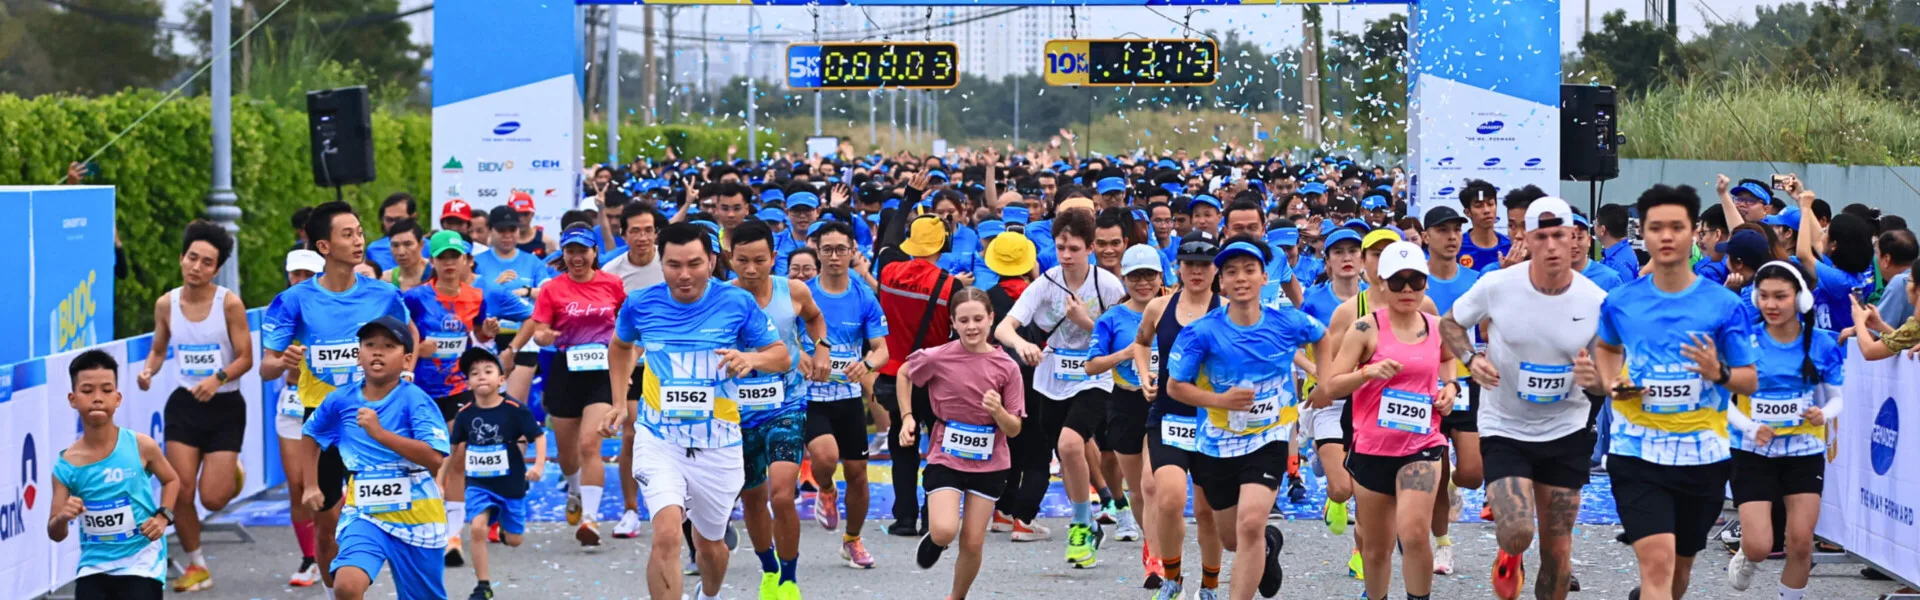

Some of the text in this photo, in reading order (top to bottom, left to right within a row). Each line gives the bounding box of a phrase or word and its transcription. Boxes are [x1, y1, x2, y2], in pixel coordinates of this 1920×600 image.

[531, 160, 560, 168] CEH
[889, 278, 930, 293] Media
[437, 340, 462, 349] 2167
[184, 353, 215, 365] 51565
[318, 347, 359, 361] 51748
[573, 351, 605, 362] 51902
[1527, 376, 1565, 390] 51731
[666, 391, 707, 403] 51562
[739, 386, 777, 399] 51829
[1649, 385, 1691, 398] 51552
[1386, 402, 1427, 420] 51290
[1756, 403, 1798, 415] 52008
[950, 432, 989, 448] 51983
[468, 455, 502, 465] 51483
[359, 483, 402, 498] 51482
[84, 512, 125, 529] 51687
